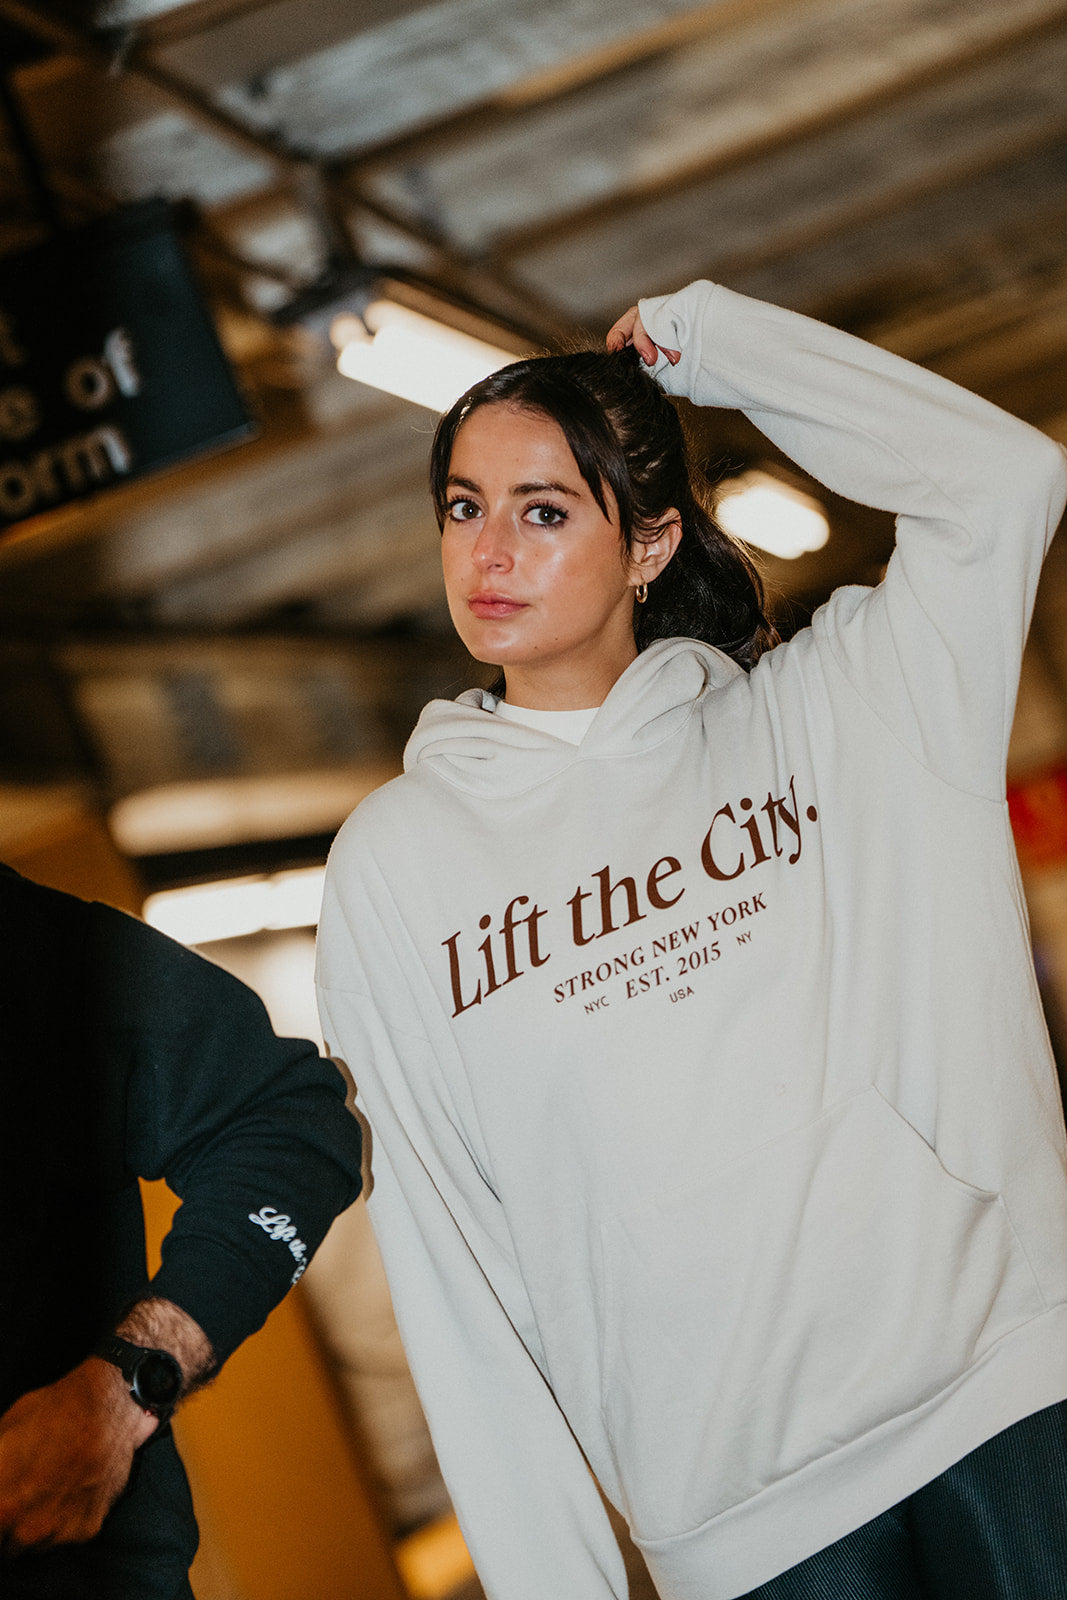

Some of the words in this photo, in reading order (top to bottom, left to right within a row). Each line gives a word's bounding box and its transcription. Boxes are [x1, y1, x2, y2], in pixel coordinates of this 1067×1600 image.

[64, 328, 140, 411] of
[441, 895, 551, 1019] Lift
[566, 856, 686, 947] the
[701, 775, 818, 881] City.
[554, 947, 645, 1003] STRONG
[652, 921, 700, 959] NEW
[707, 892, 767, 932] YORK
[583, 995, 610, 1015] NYC
[625, 965, 670, 1000] EST.
[677, 941, 722, 977] 2015
[735, 930, 753, 947] NY
[669, 986, 694, 1004] USA
